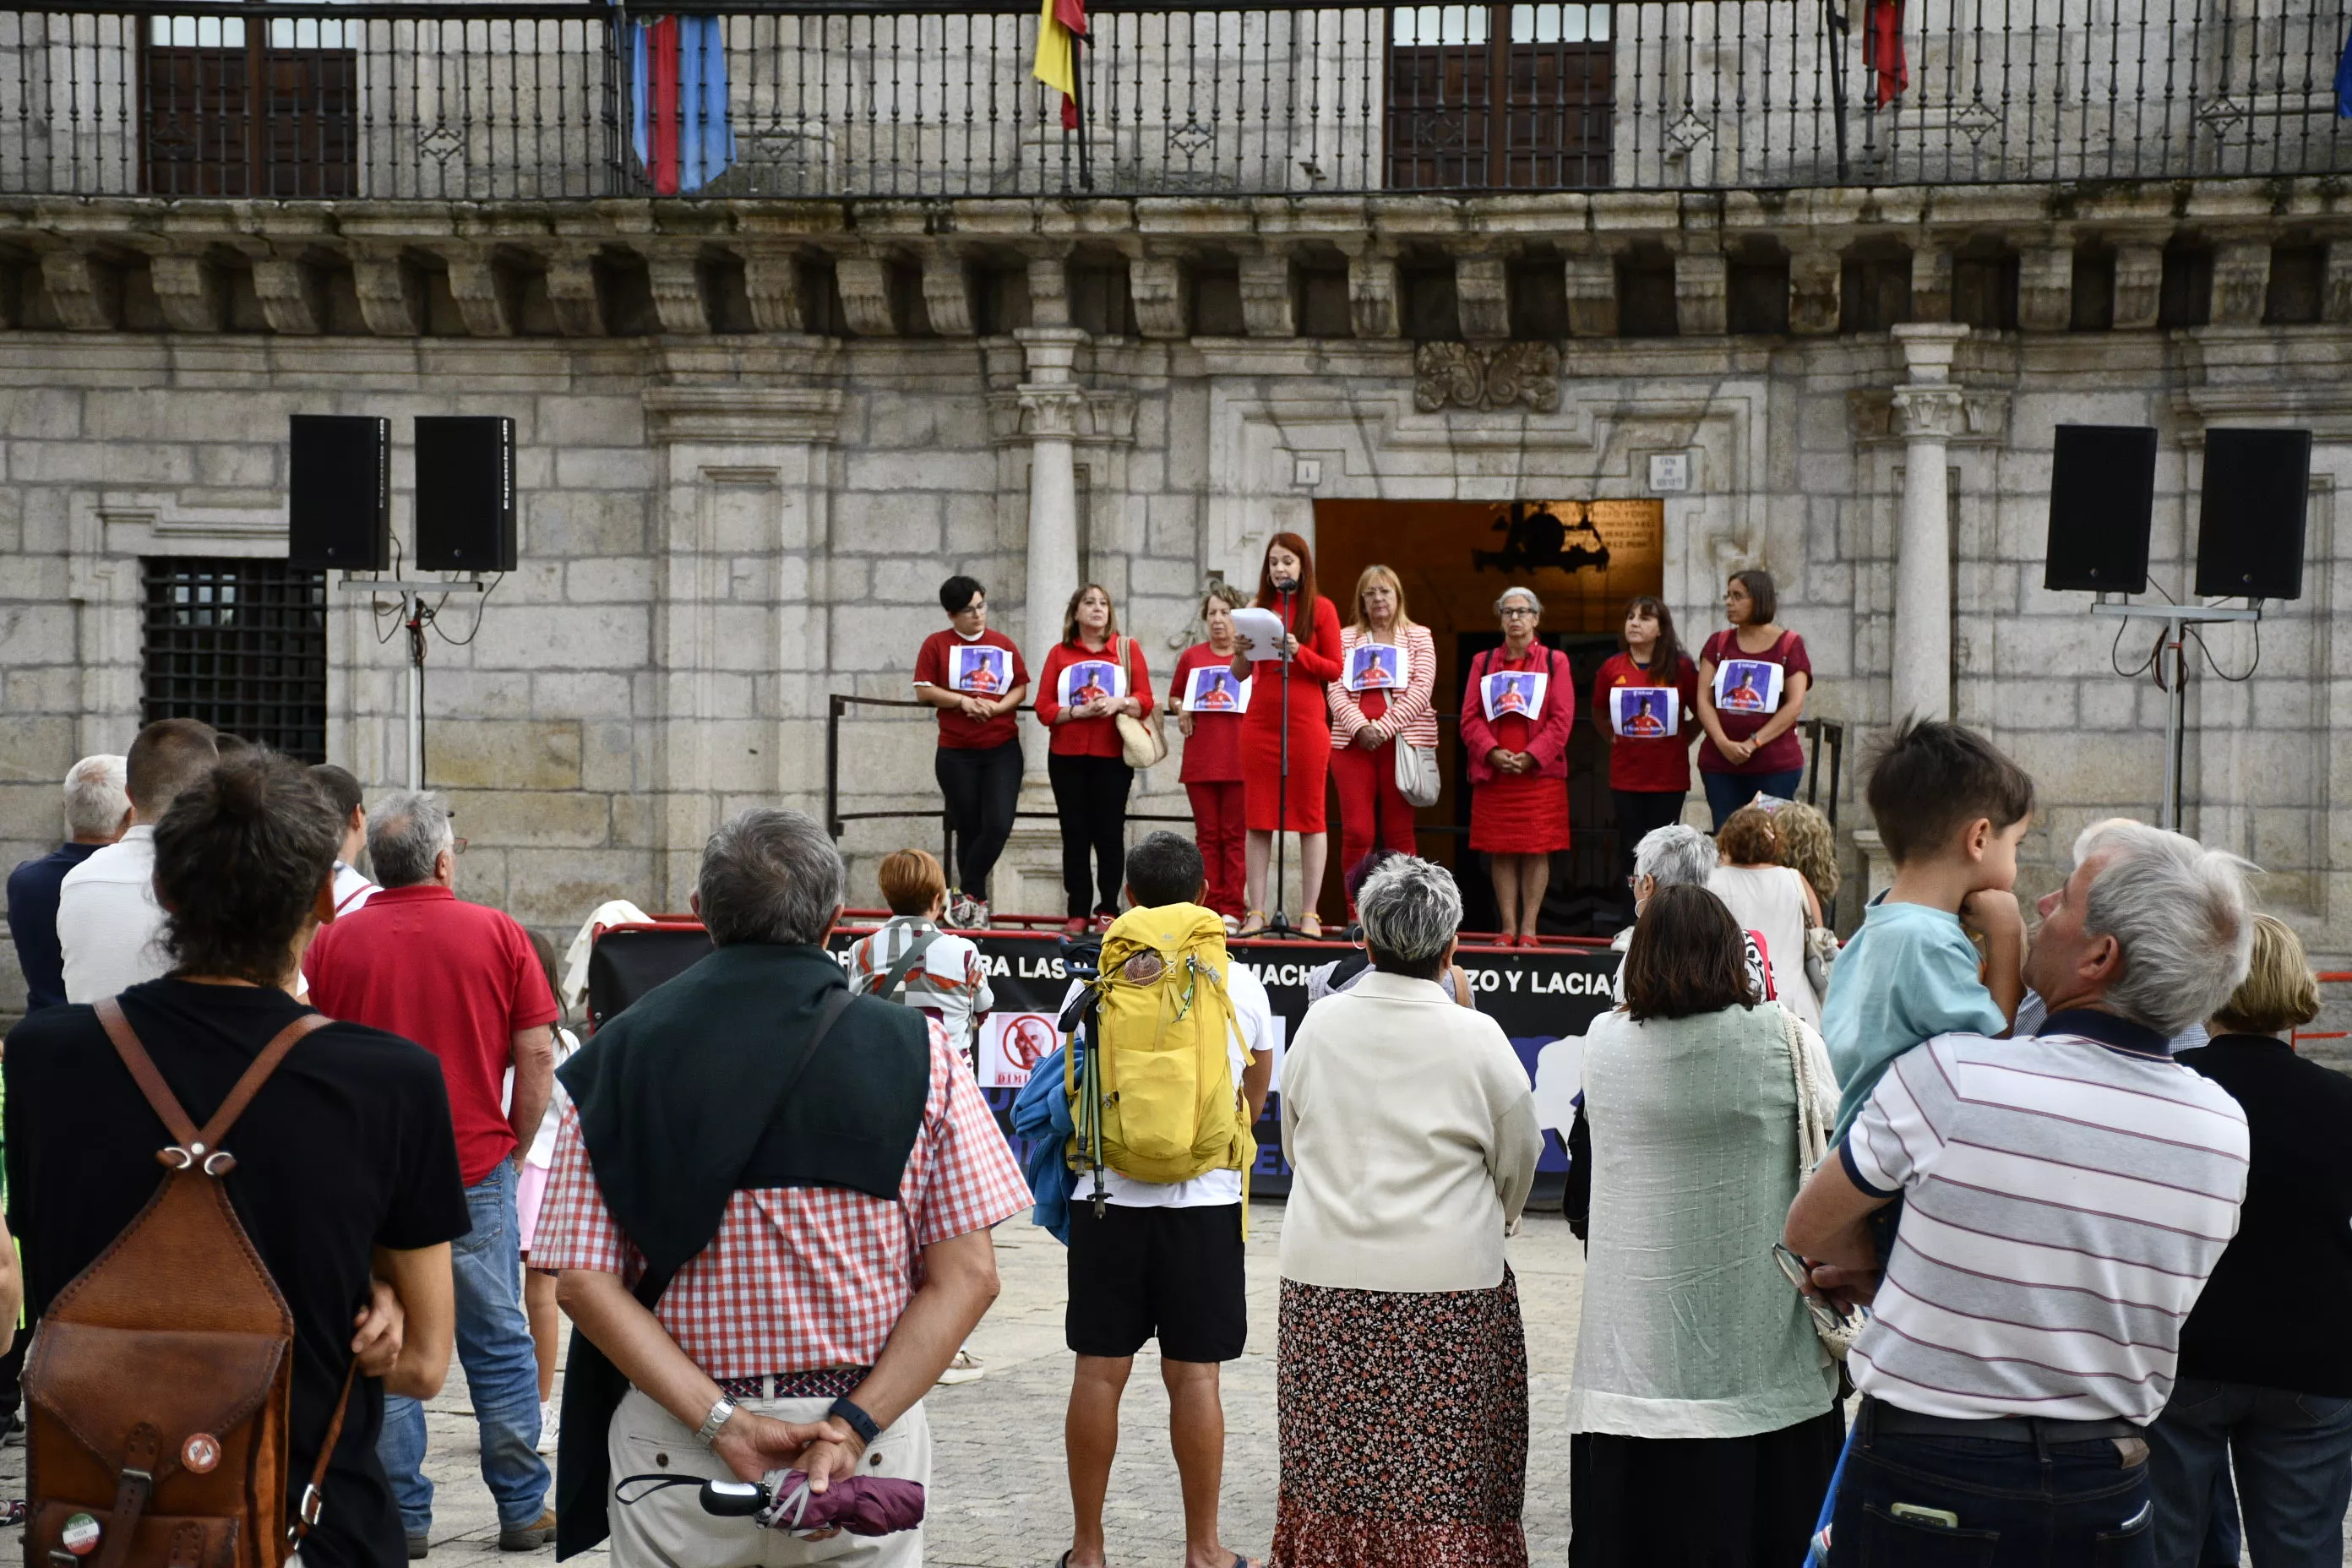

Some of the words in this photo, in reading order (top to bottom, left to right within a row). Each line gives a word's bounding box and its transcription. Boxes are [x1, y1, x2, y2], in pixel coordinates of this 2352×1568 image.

[982, 955, 1011, 977] RA
[1019, 956, 1067, 980] LAS
[1243, 963, 1313, 987] MACH
[1464, 969, 1500, 992] ZO
[1505, 971, 1523, 993] Y
[1531, 971, 1612, 995] LACIA
[997, 1074, 1029, 1084] DIMI
